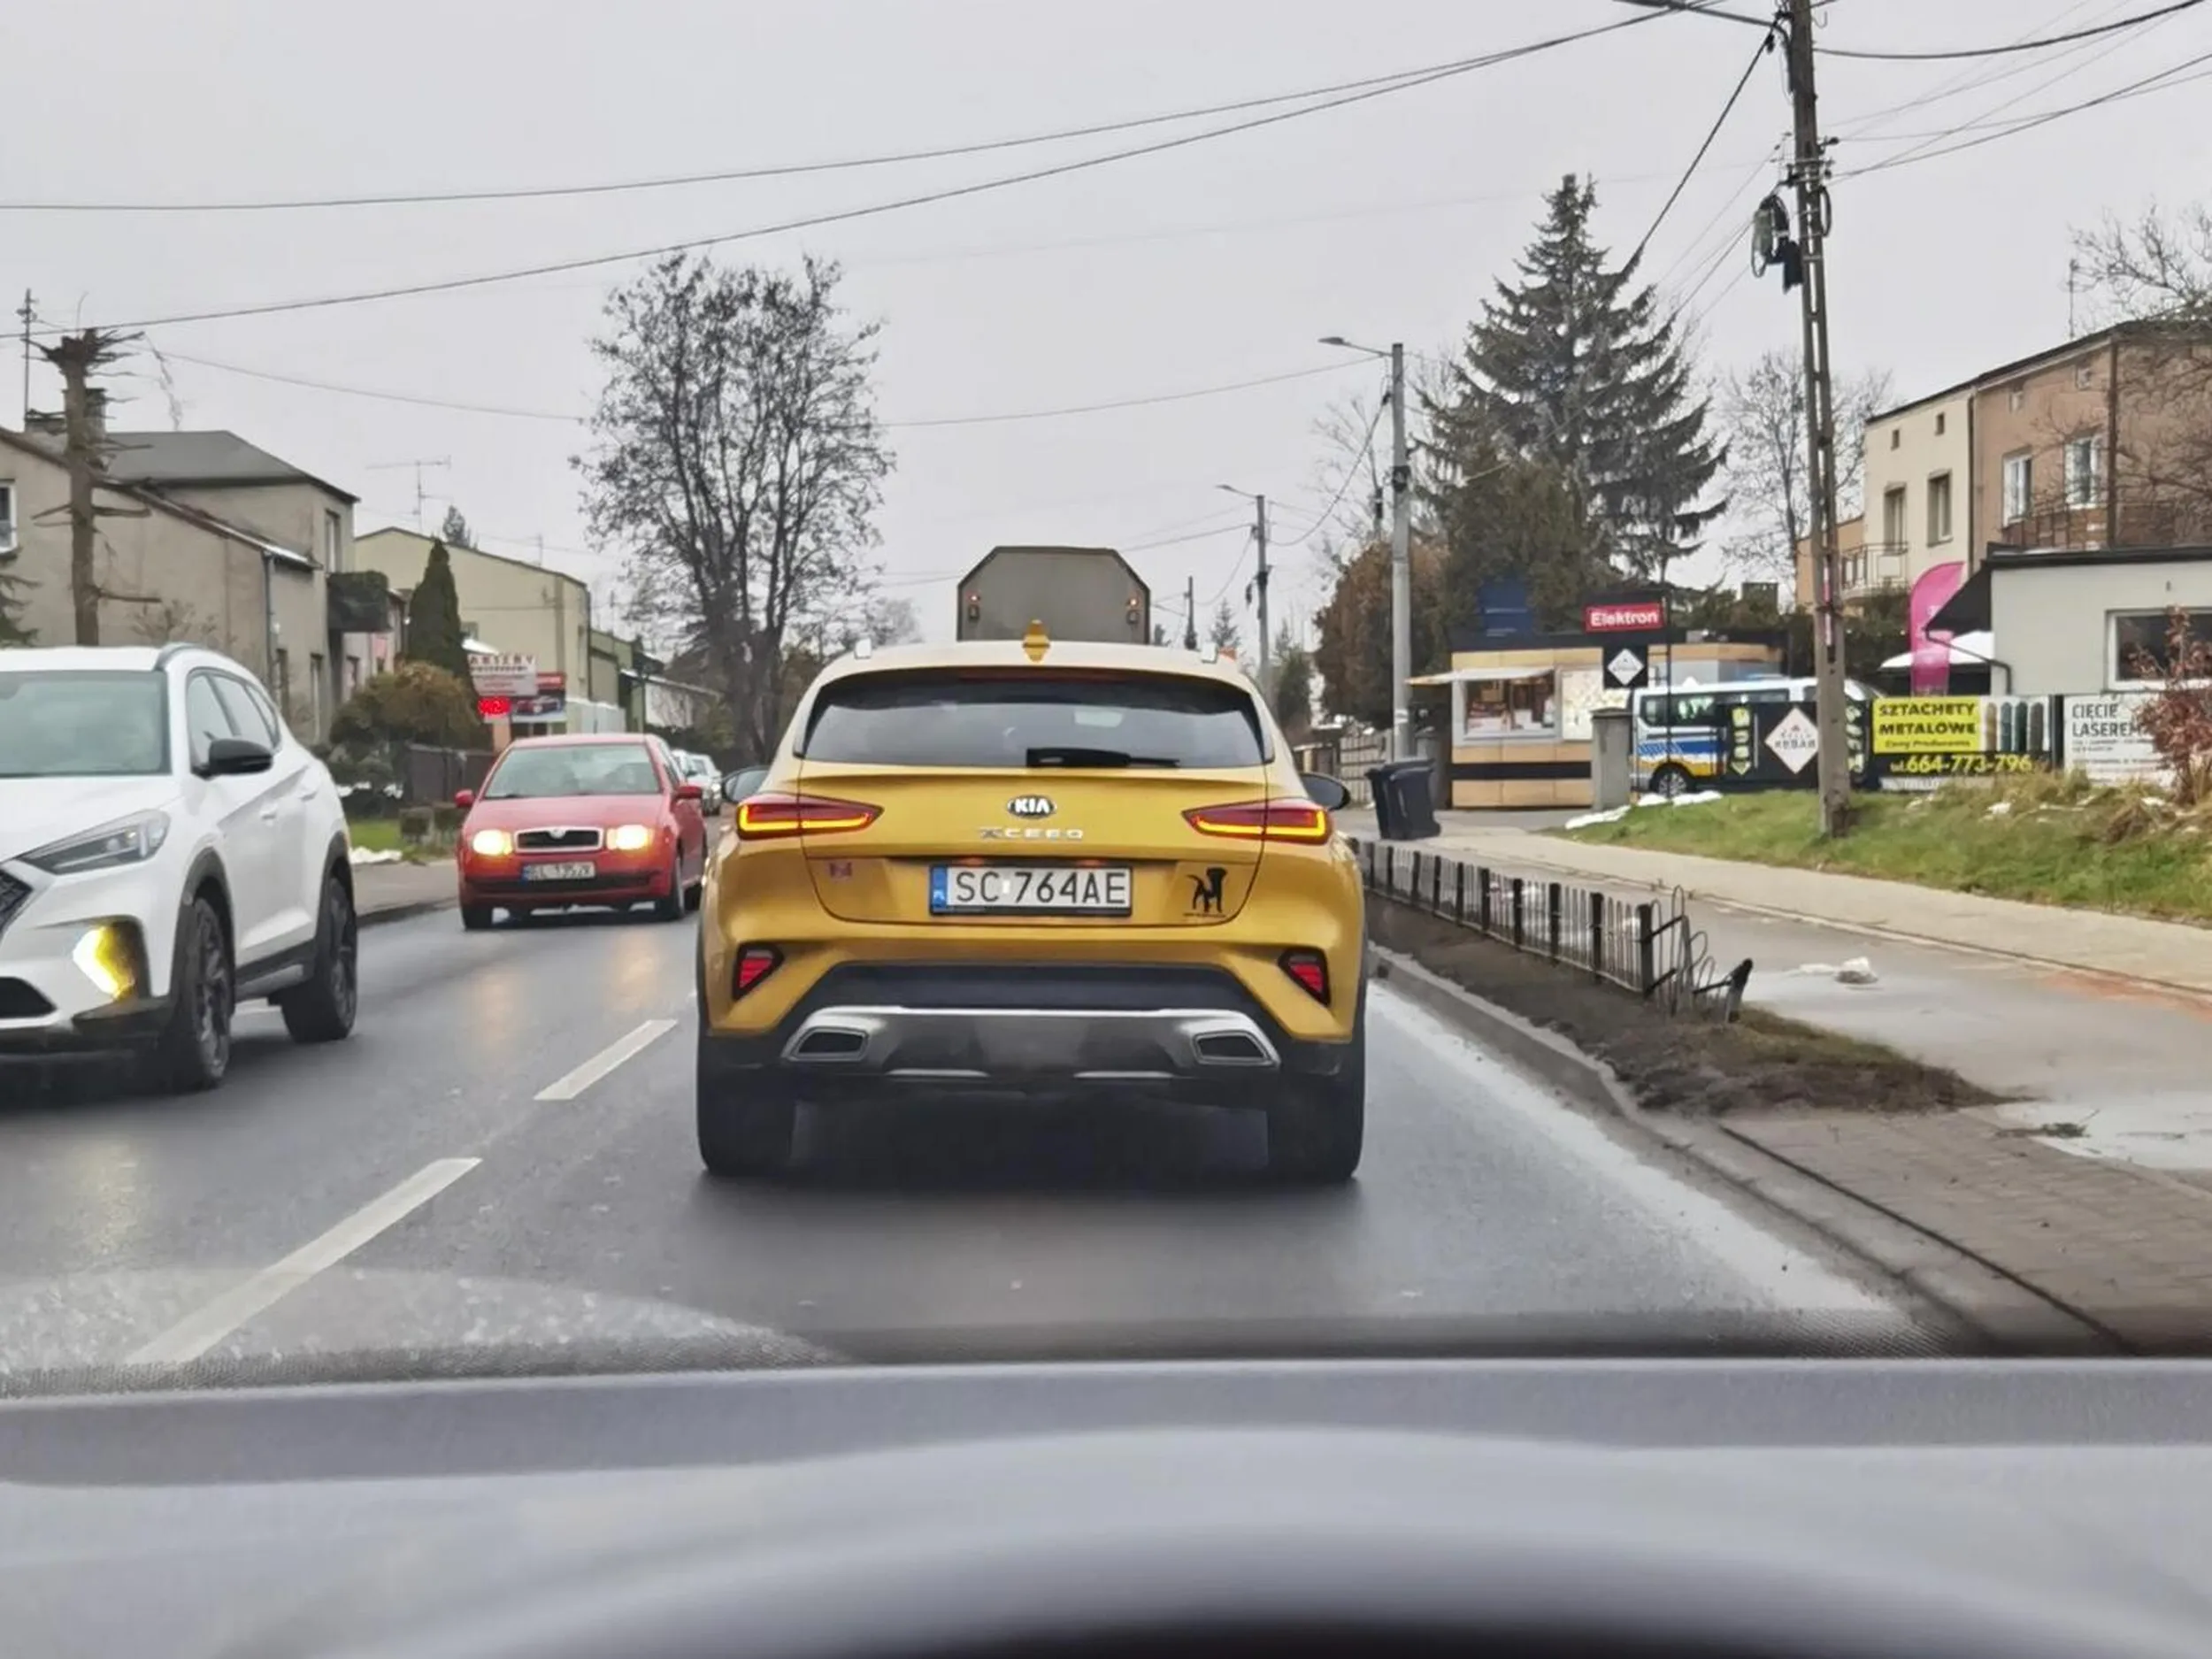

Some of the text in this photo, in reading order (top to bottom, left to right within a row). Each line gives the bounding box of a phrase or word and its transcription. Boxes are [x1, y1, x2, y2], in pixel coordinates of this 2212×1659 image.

[1590, 611, 1659, 627] Elektron
[1878, 702, 1976, 718] SZTACHETY
[1907, 754, 2033, 773] 664-773-796
[1015, 798, 1050, 813] KIA
[956, 871, 1126, 904] SC 764AE
